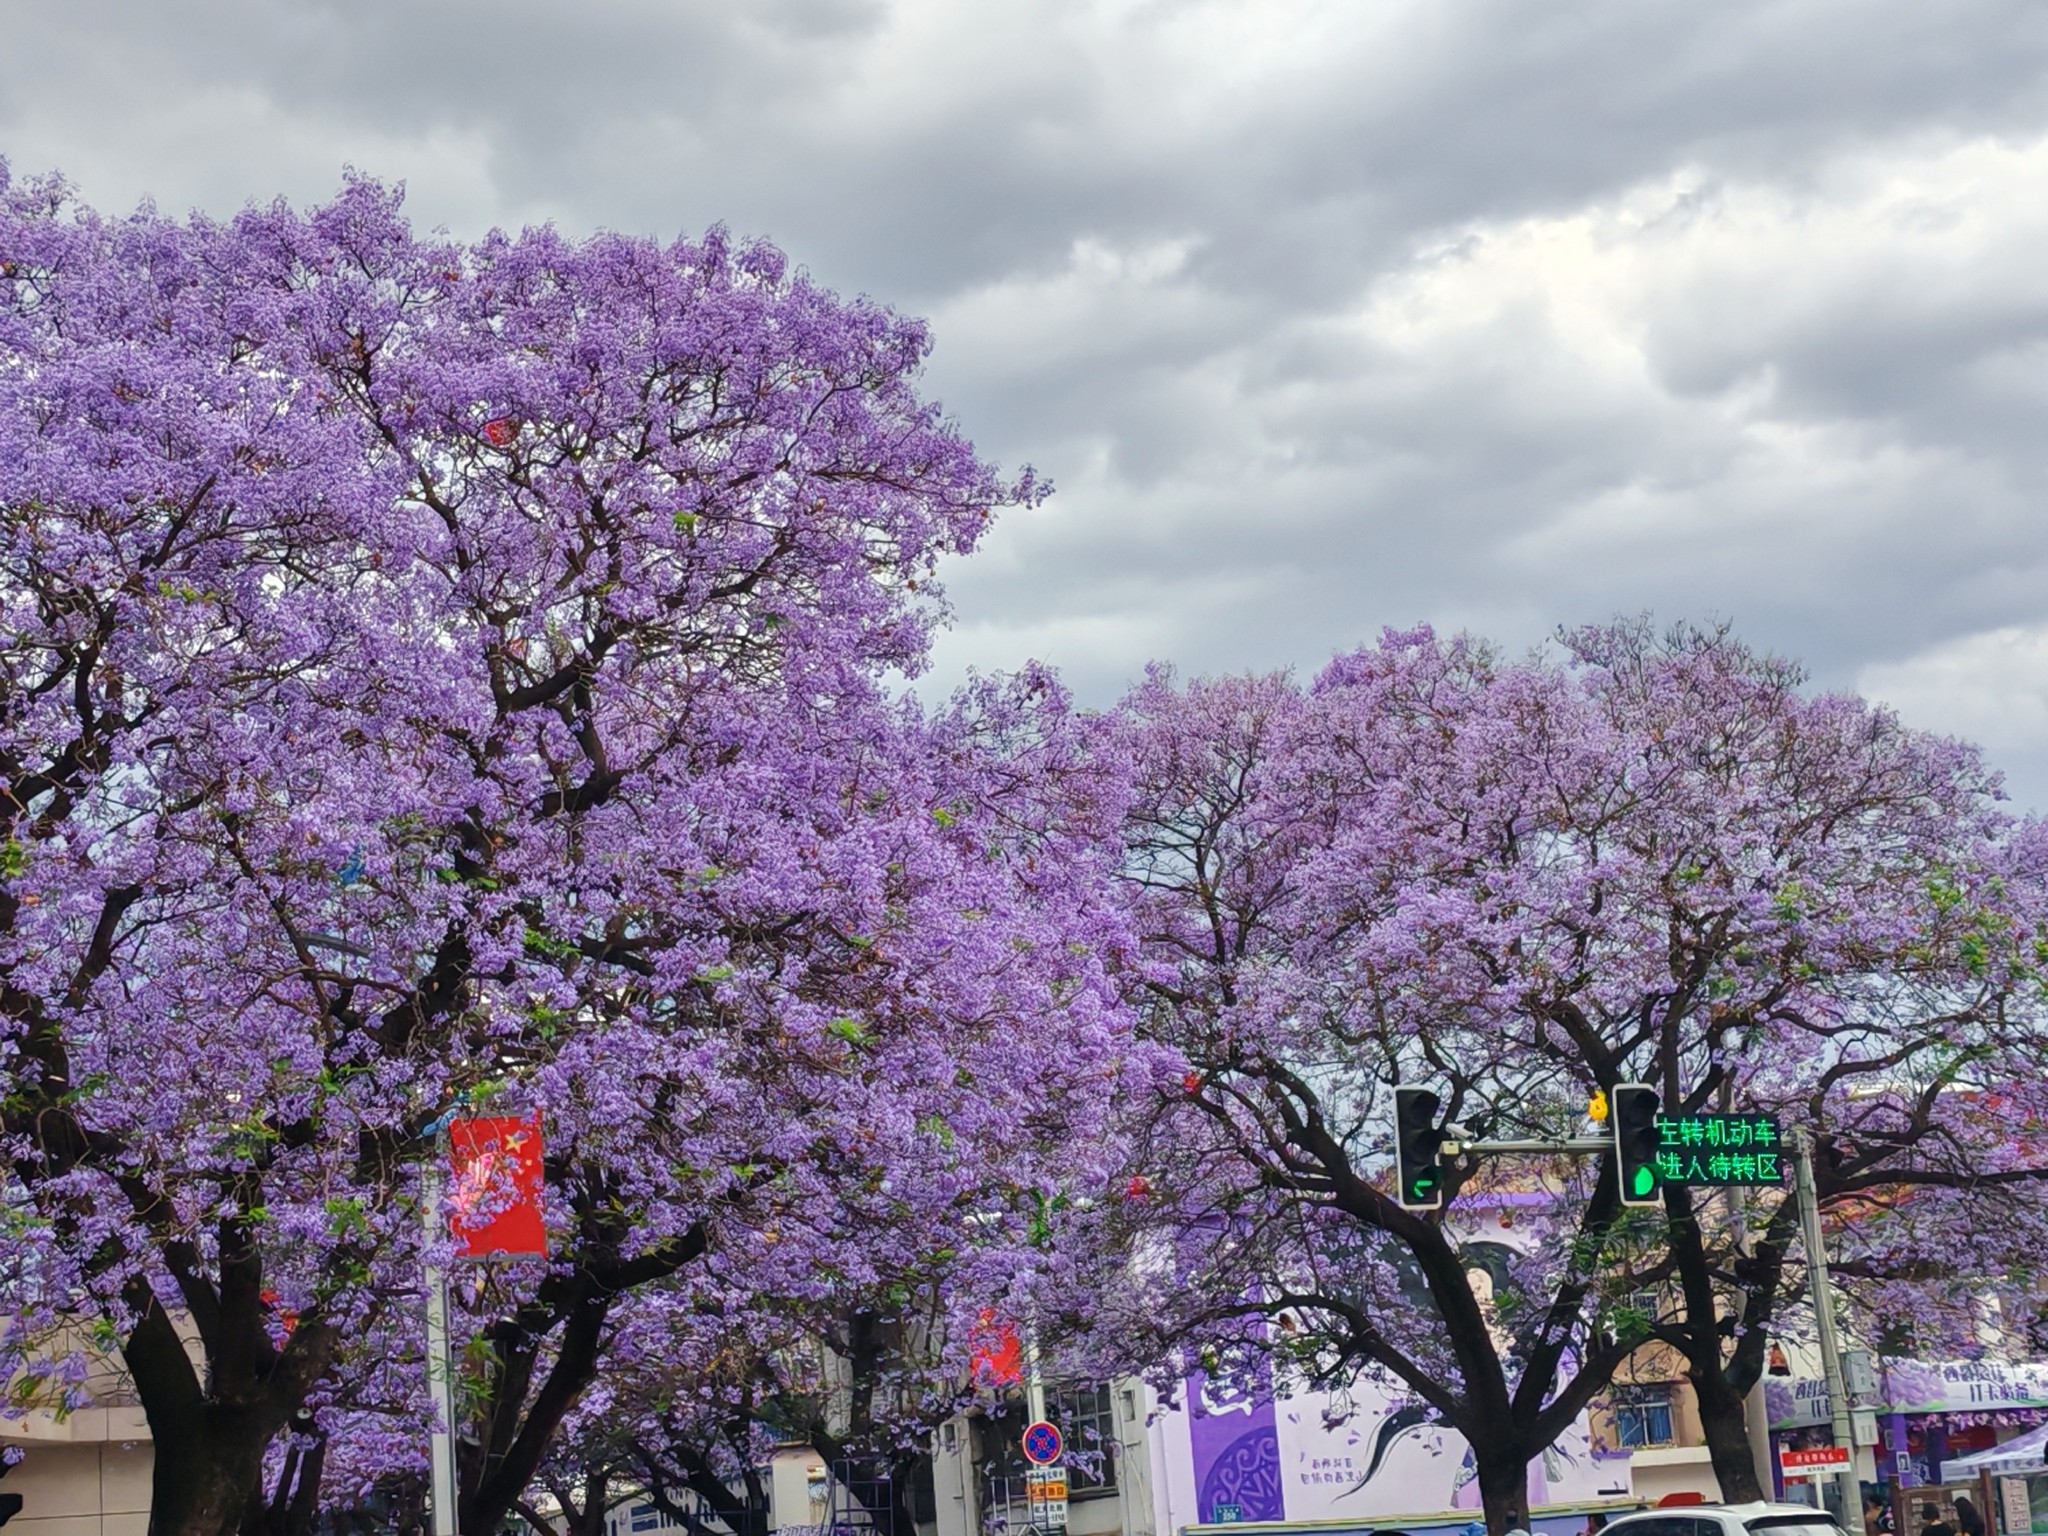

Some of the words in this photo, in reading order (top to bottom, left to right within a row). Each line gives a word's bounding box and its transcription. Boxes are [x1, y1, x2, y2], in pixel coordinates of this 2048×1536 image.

[1656, 1117, 1778, 1147] 左转机动车
